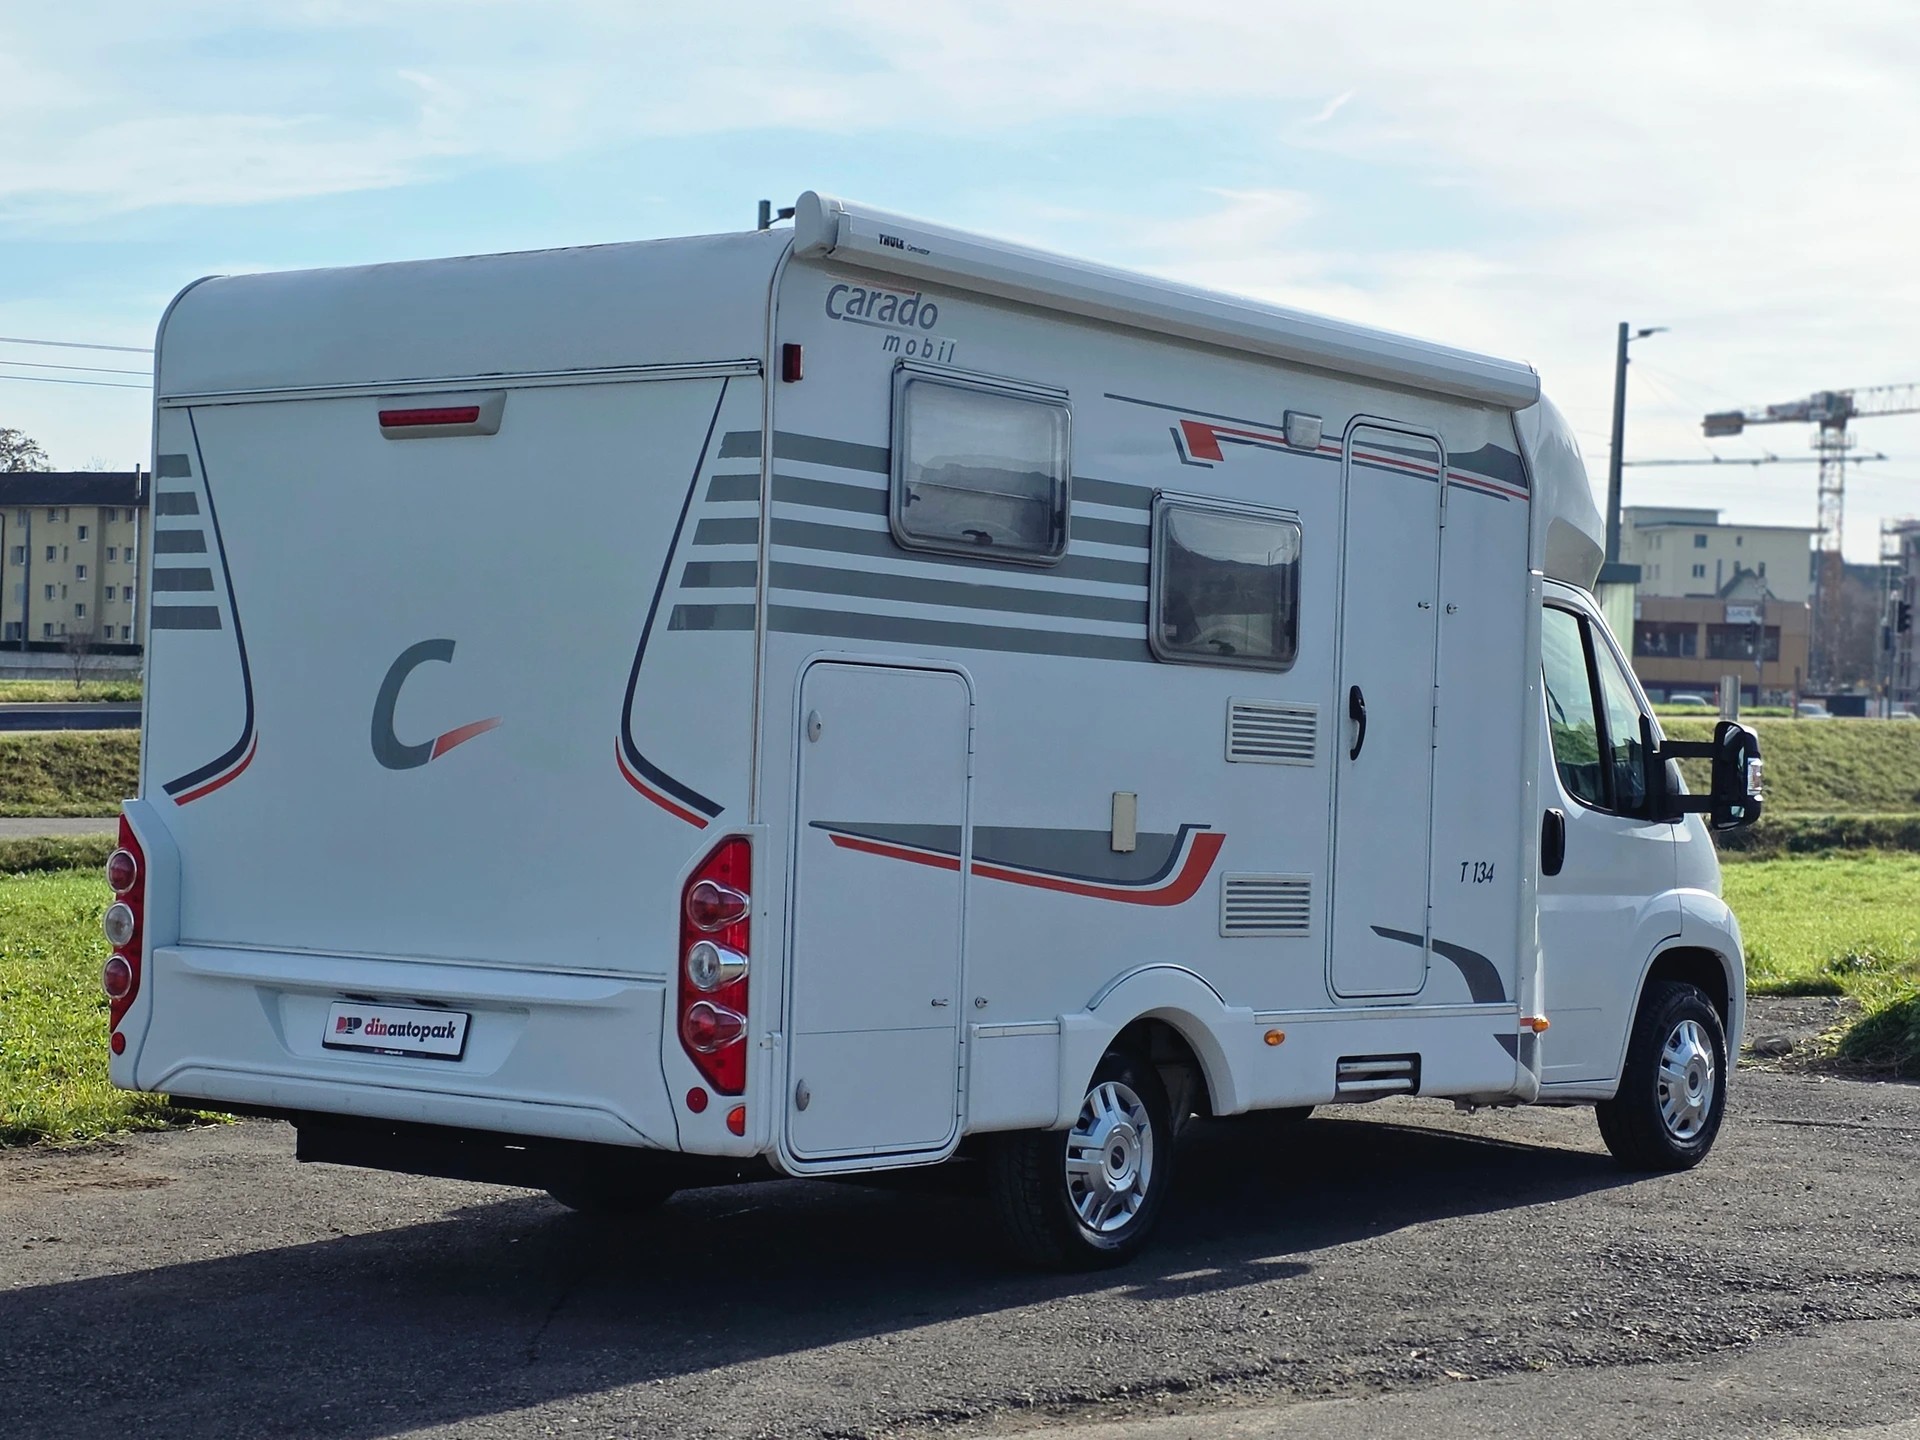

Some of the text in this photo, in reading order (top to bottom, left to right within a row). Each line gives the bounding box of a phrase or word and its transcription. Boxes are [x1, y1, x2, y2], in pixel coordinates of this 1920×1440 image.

[878, 234, 904, 249] THULE
[825, 284, 938, 330] Carado
[882, 335, 955, 363] mobil
[1460, 861, 1494, 883] T 134
[365, 1017, 456, 1042] dinautopark
